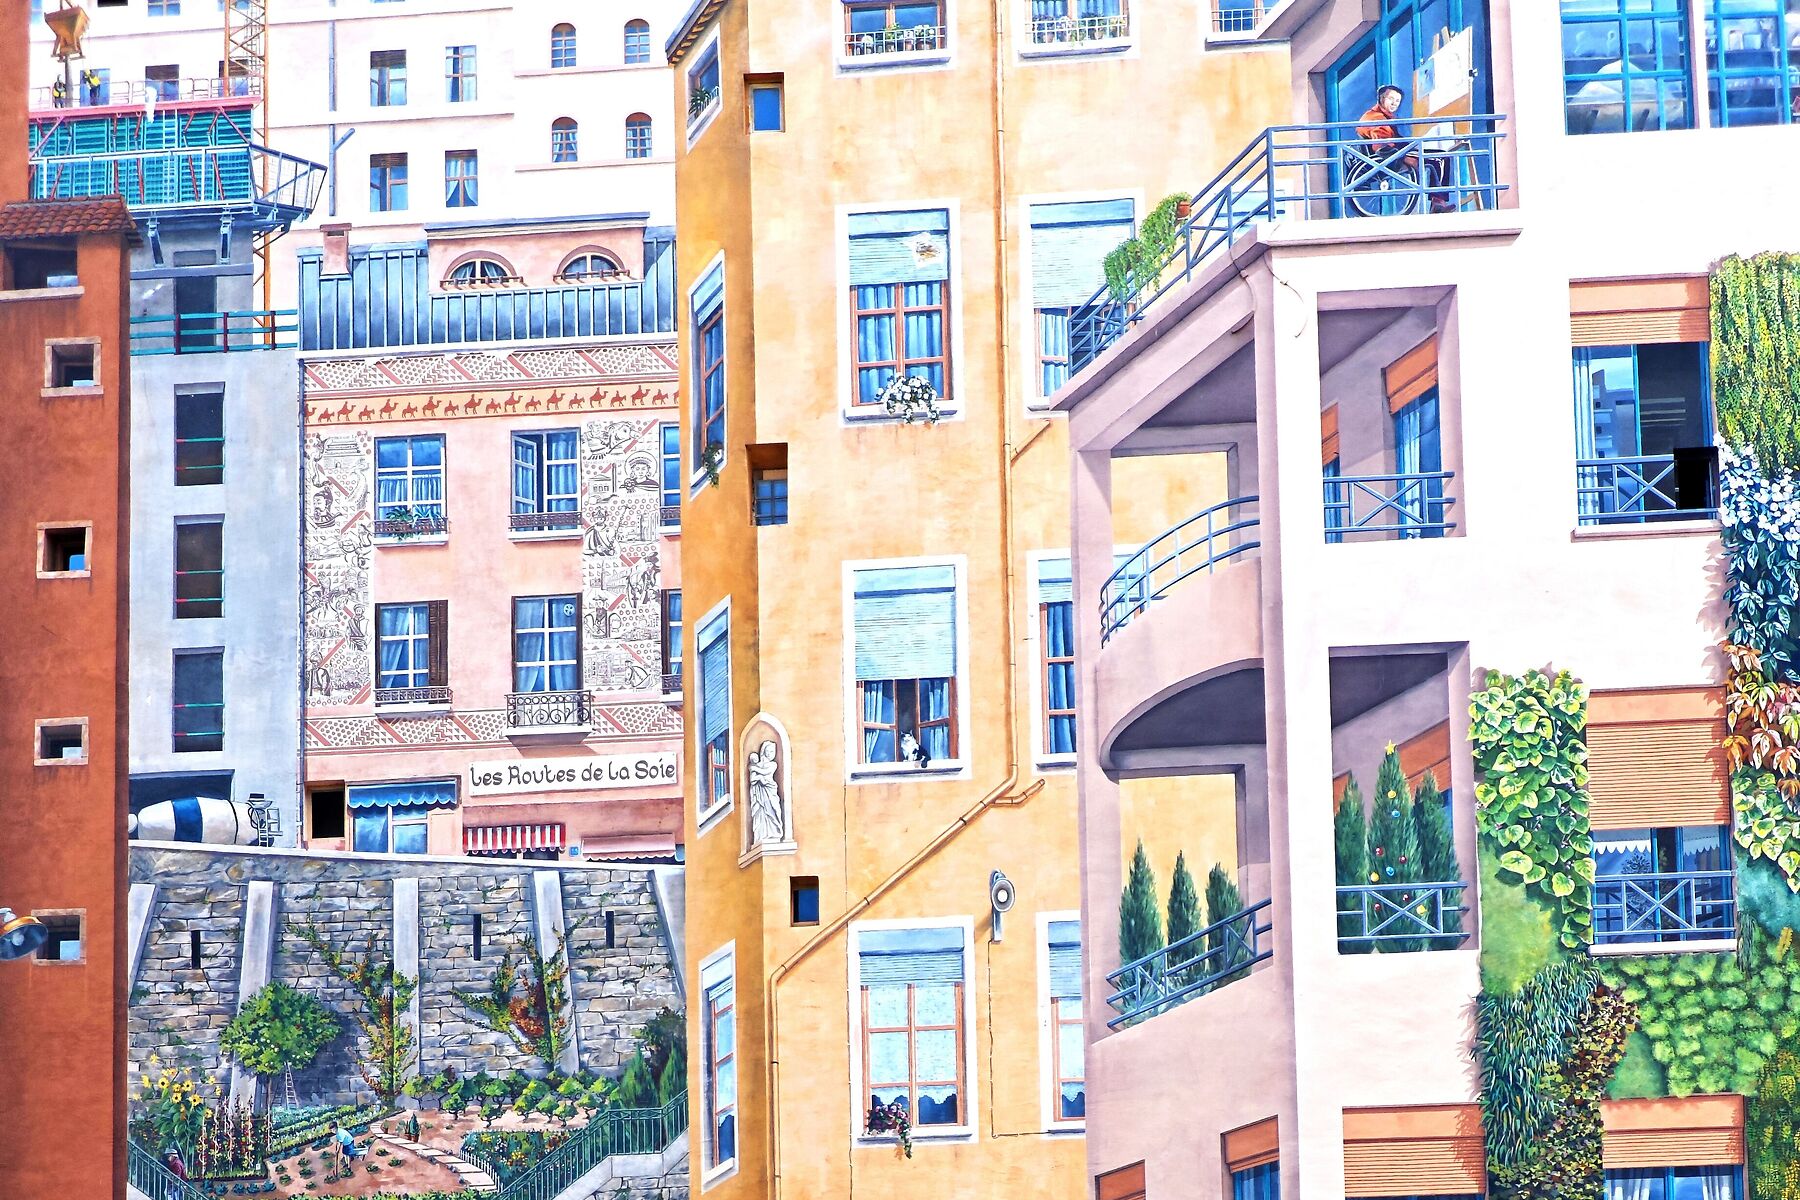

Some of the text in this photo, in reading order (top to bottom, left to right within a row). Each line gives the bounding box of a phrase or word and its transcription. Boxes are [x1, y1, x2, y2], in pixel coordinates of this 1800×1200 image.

[508, 765, 576, 785] Routes
[581, 762, 603, 781] de
[634, 757, 676, 779] Soie
